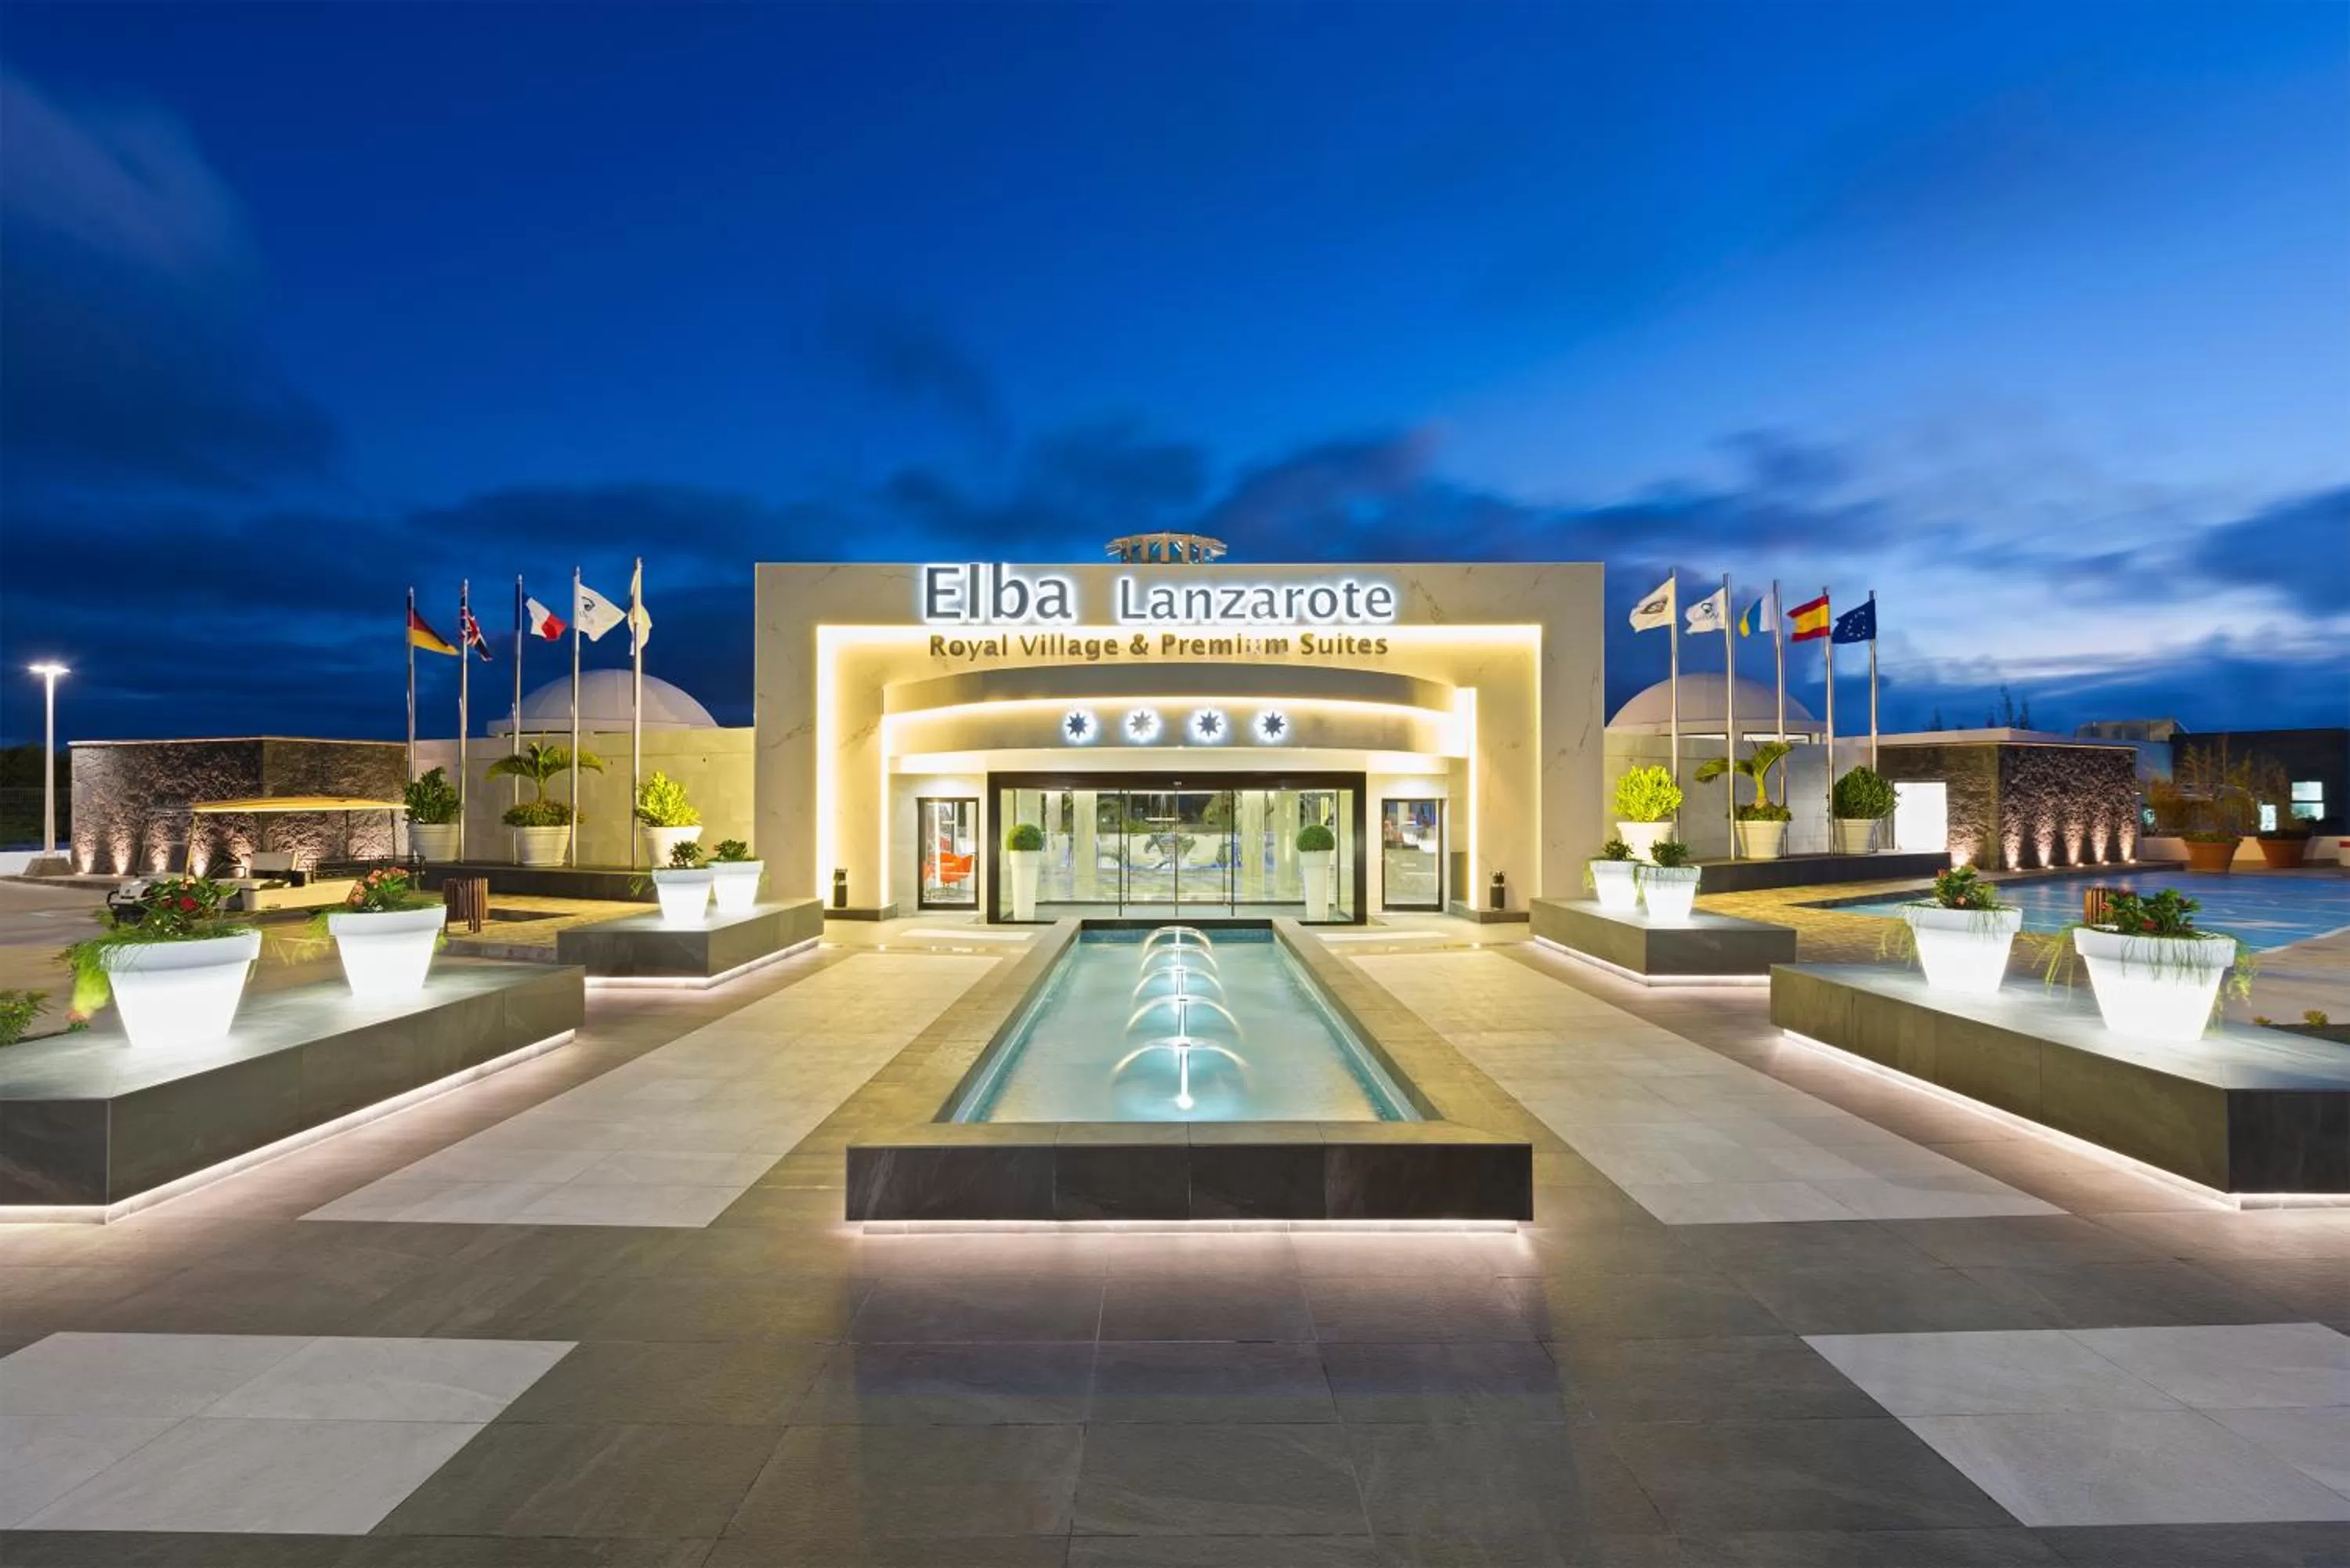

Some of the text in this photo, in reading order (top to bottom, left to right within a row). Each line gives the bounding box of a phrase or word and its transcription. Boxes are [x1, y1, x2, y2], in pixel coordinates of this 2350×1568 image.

[926, 562, 1393, 620] Elba Lanzarote
[929, 634, 1007, 662] Royal
[1019, 634, 1119, 661] Village
[1129, 634, 1149, 656] &
[1300, 632, 1389, 656] Suites
